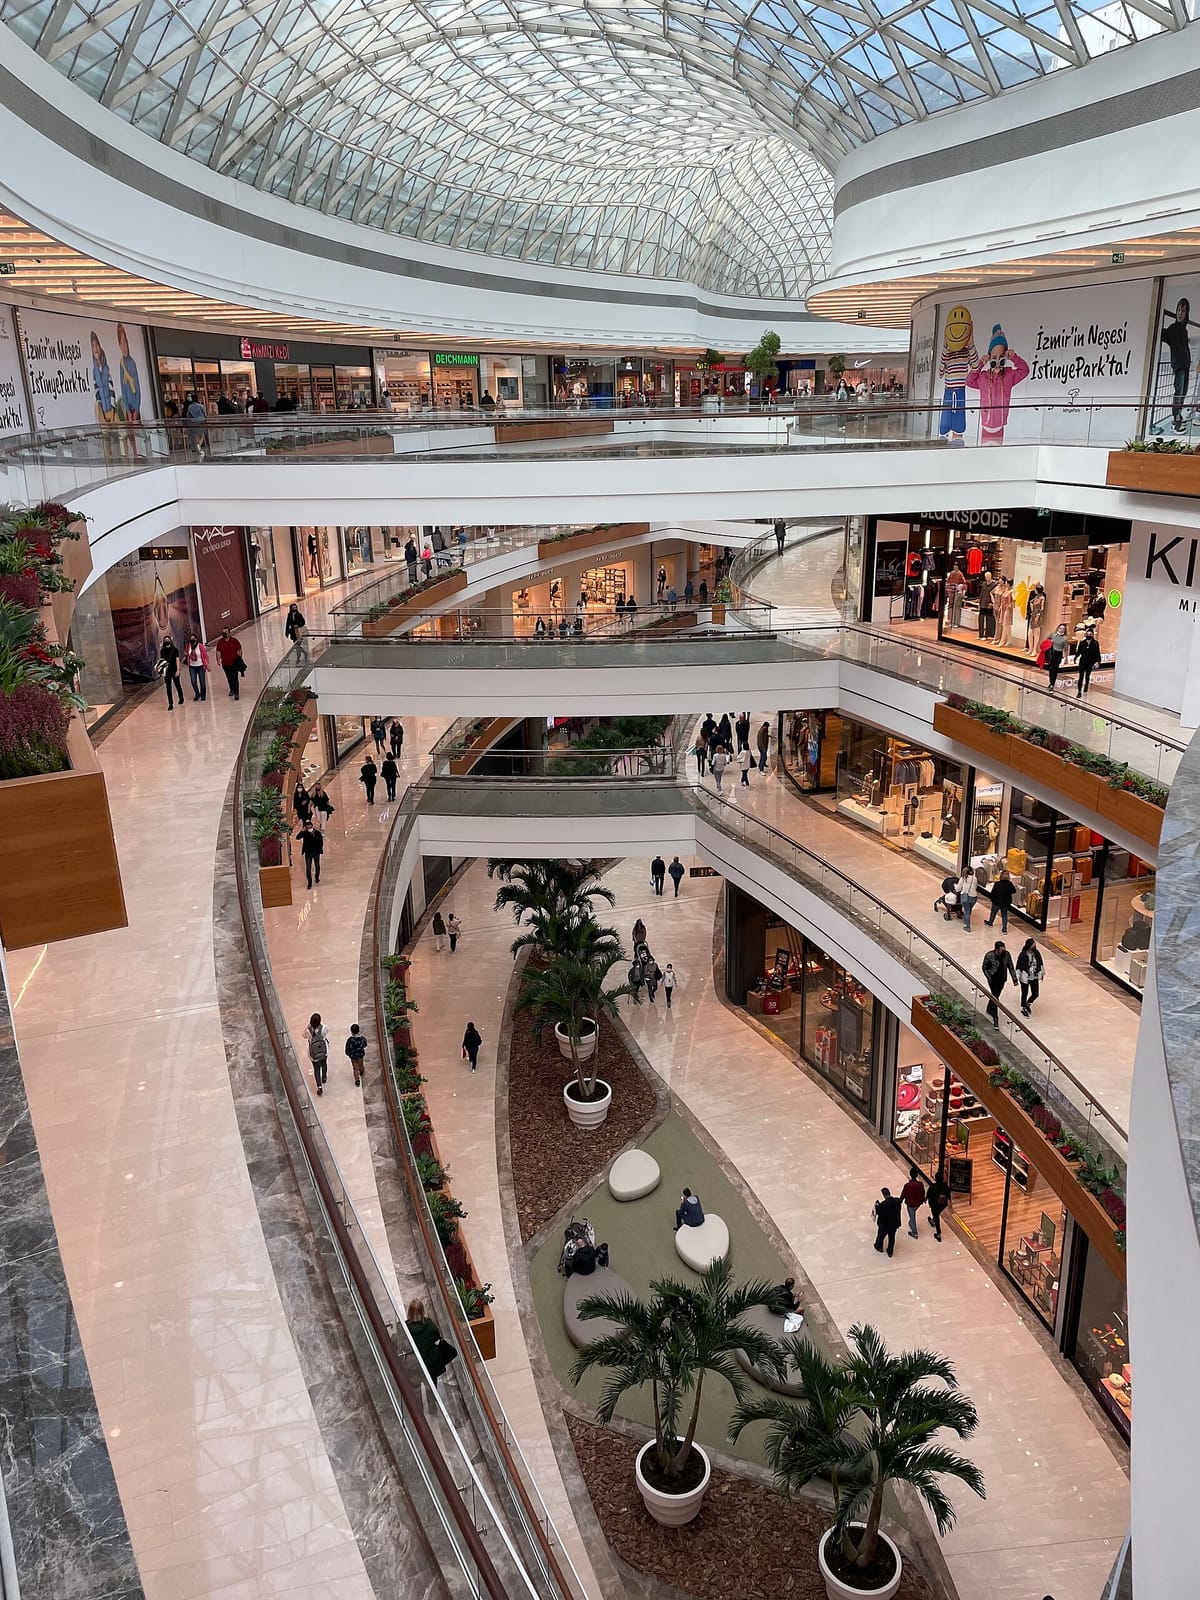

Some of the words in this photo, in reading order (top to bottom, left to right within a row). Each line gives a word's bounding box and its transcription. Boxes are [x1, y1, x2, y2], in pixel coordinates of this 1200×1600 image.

[1036, 325, 1085, 351] İzmir'in
[1088, 321, 1128, 350] Neşesi
[435, 353, 478, 365] DEICHMANN
[1030, 350, 1131, 384] İstinyePark'ta!
